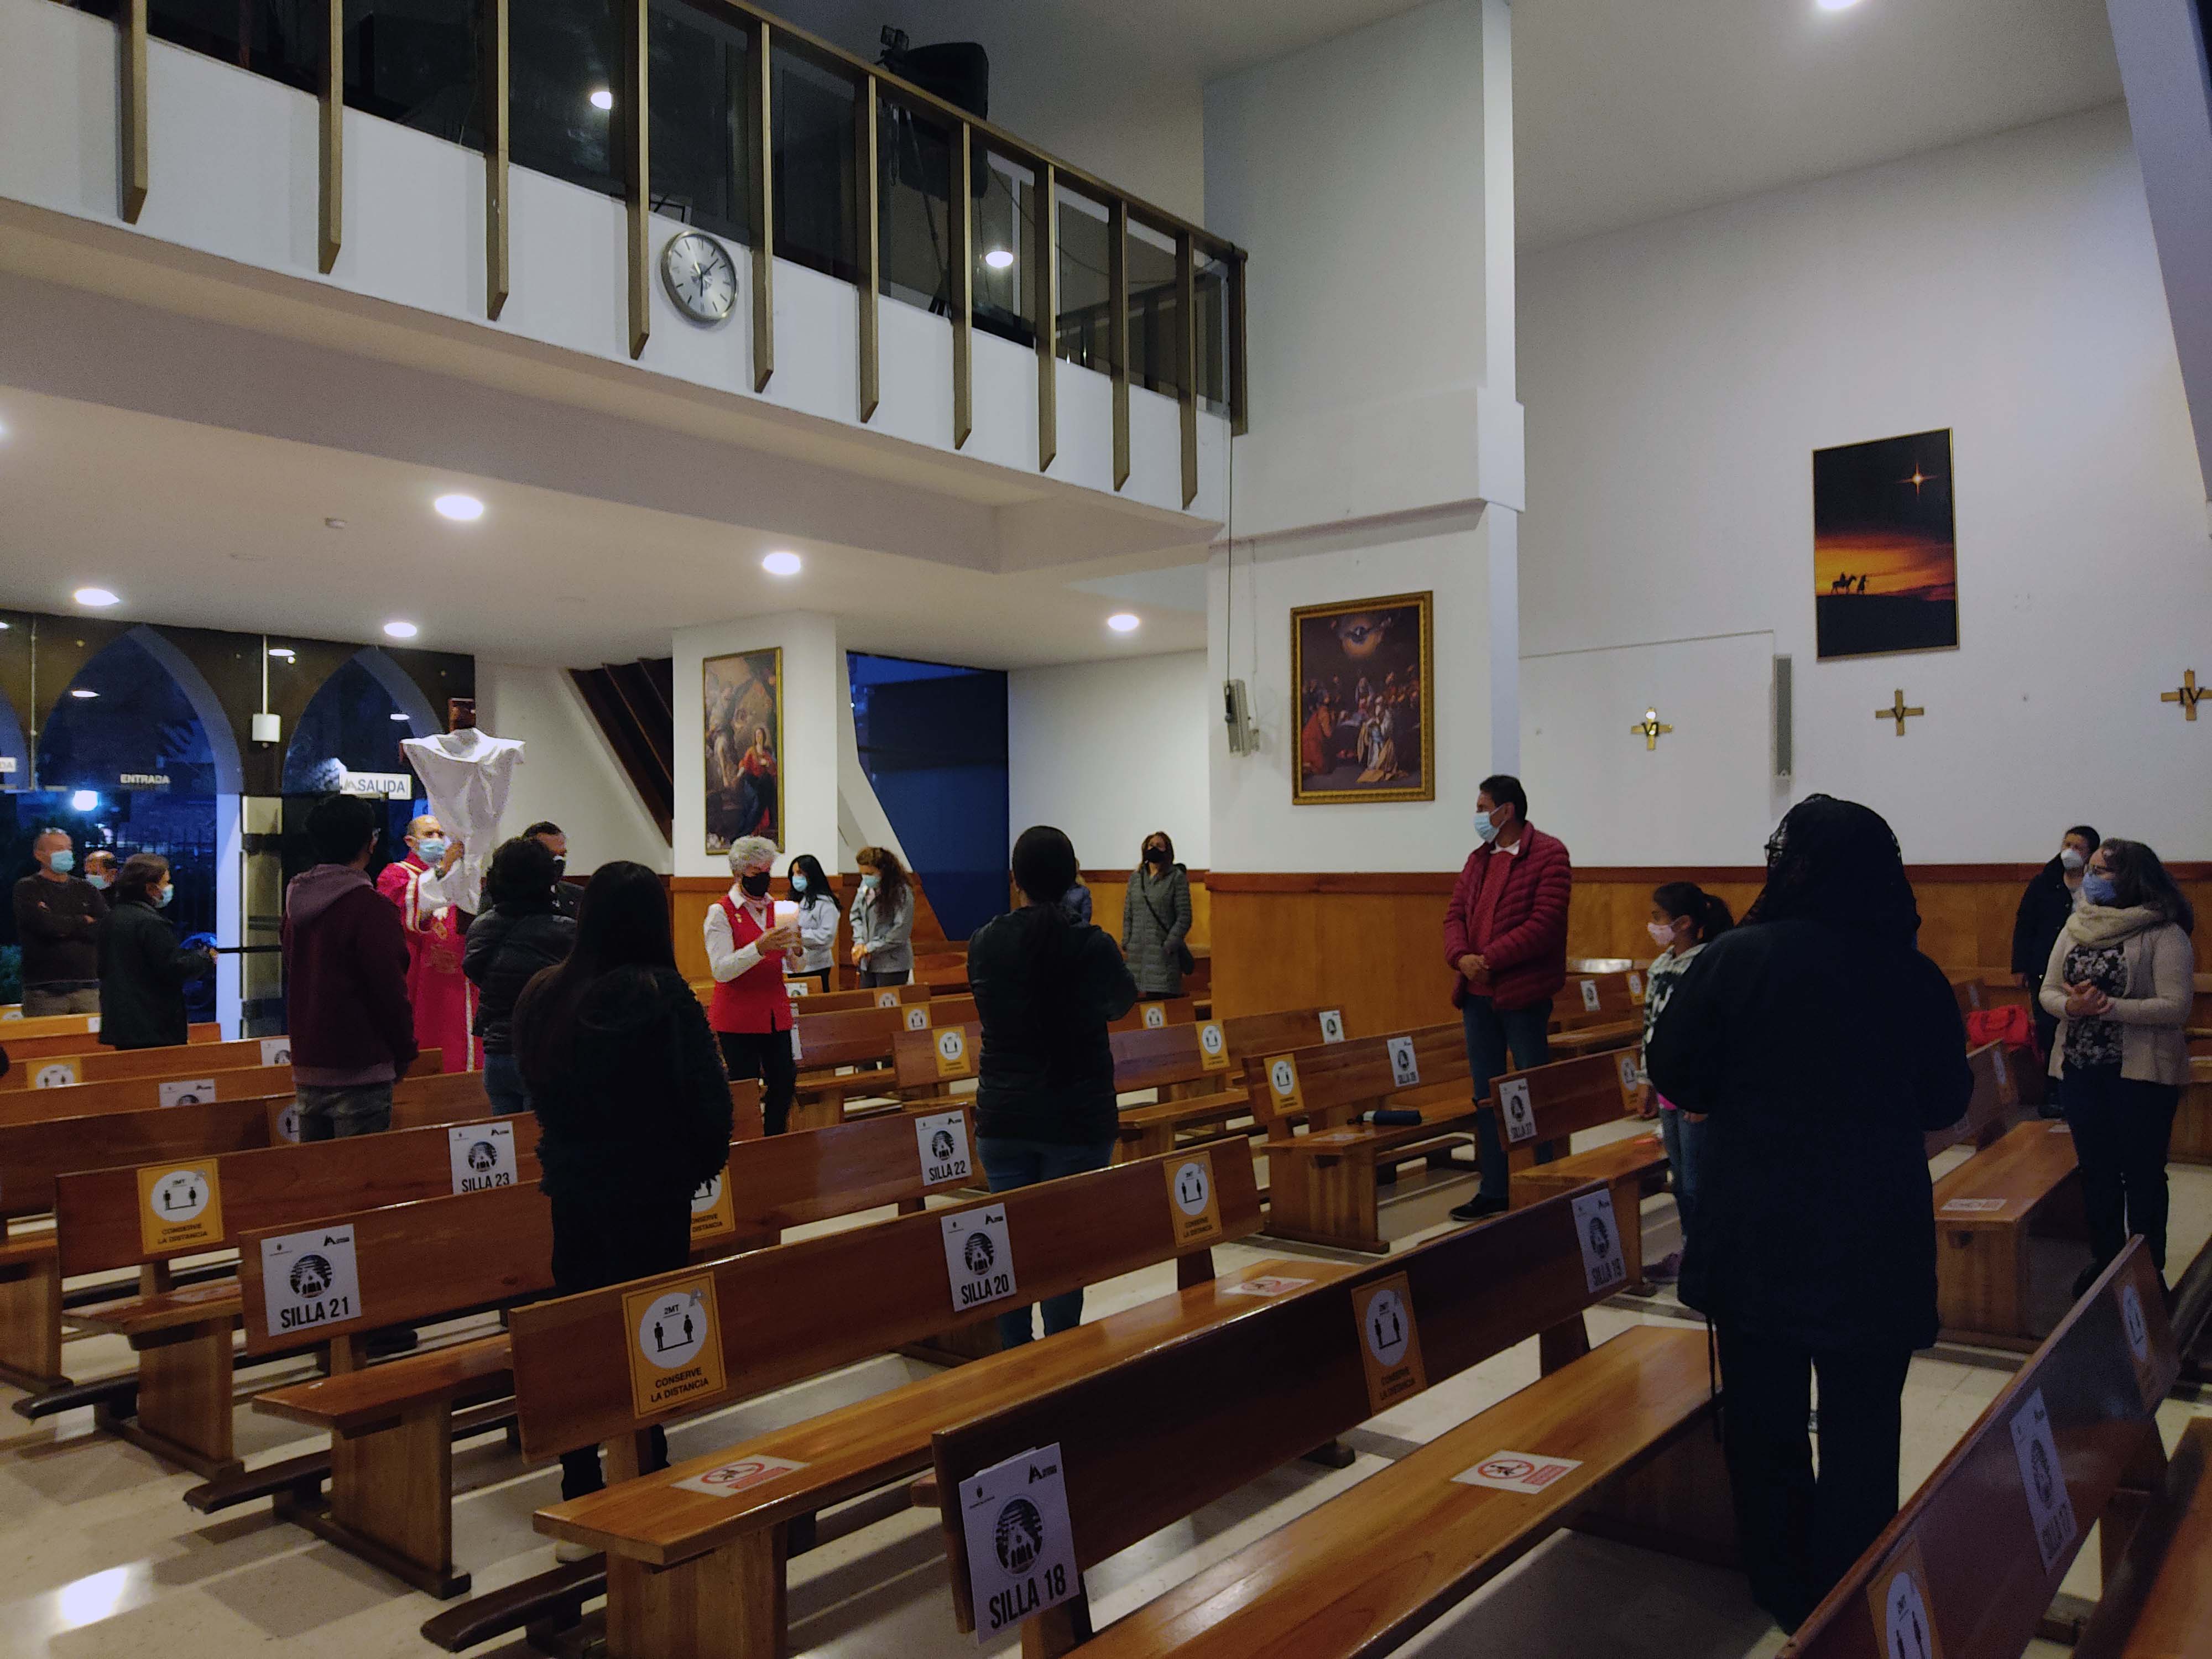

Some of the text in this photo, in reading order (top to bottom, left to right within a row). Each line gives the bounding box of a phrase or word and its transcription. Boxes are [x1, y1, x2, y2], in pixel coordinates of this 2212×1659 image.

[2178, 686, 2206, 706] IV
[1891, 706, 1907, 722] V
[120, 774, 171, 784] ENTRADA
[358, 779, 405, 793] SALIDA
[929, 1160, 966, 1181] SILLA 22
[461, 1172, 510, 1193] SILLA 23
[961, 1274, 1009, 1305] SILLA 20
[280, 1296, 349, 1328] SILLA 21
[664, 1304, 680, 1314] 2MT
[655, 1367, 702, 1389] CONSERVE
[651, 1378, 709, 1403] LA DISTANCIA
[989, 1563, 1066, 1630] SILLA 18
